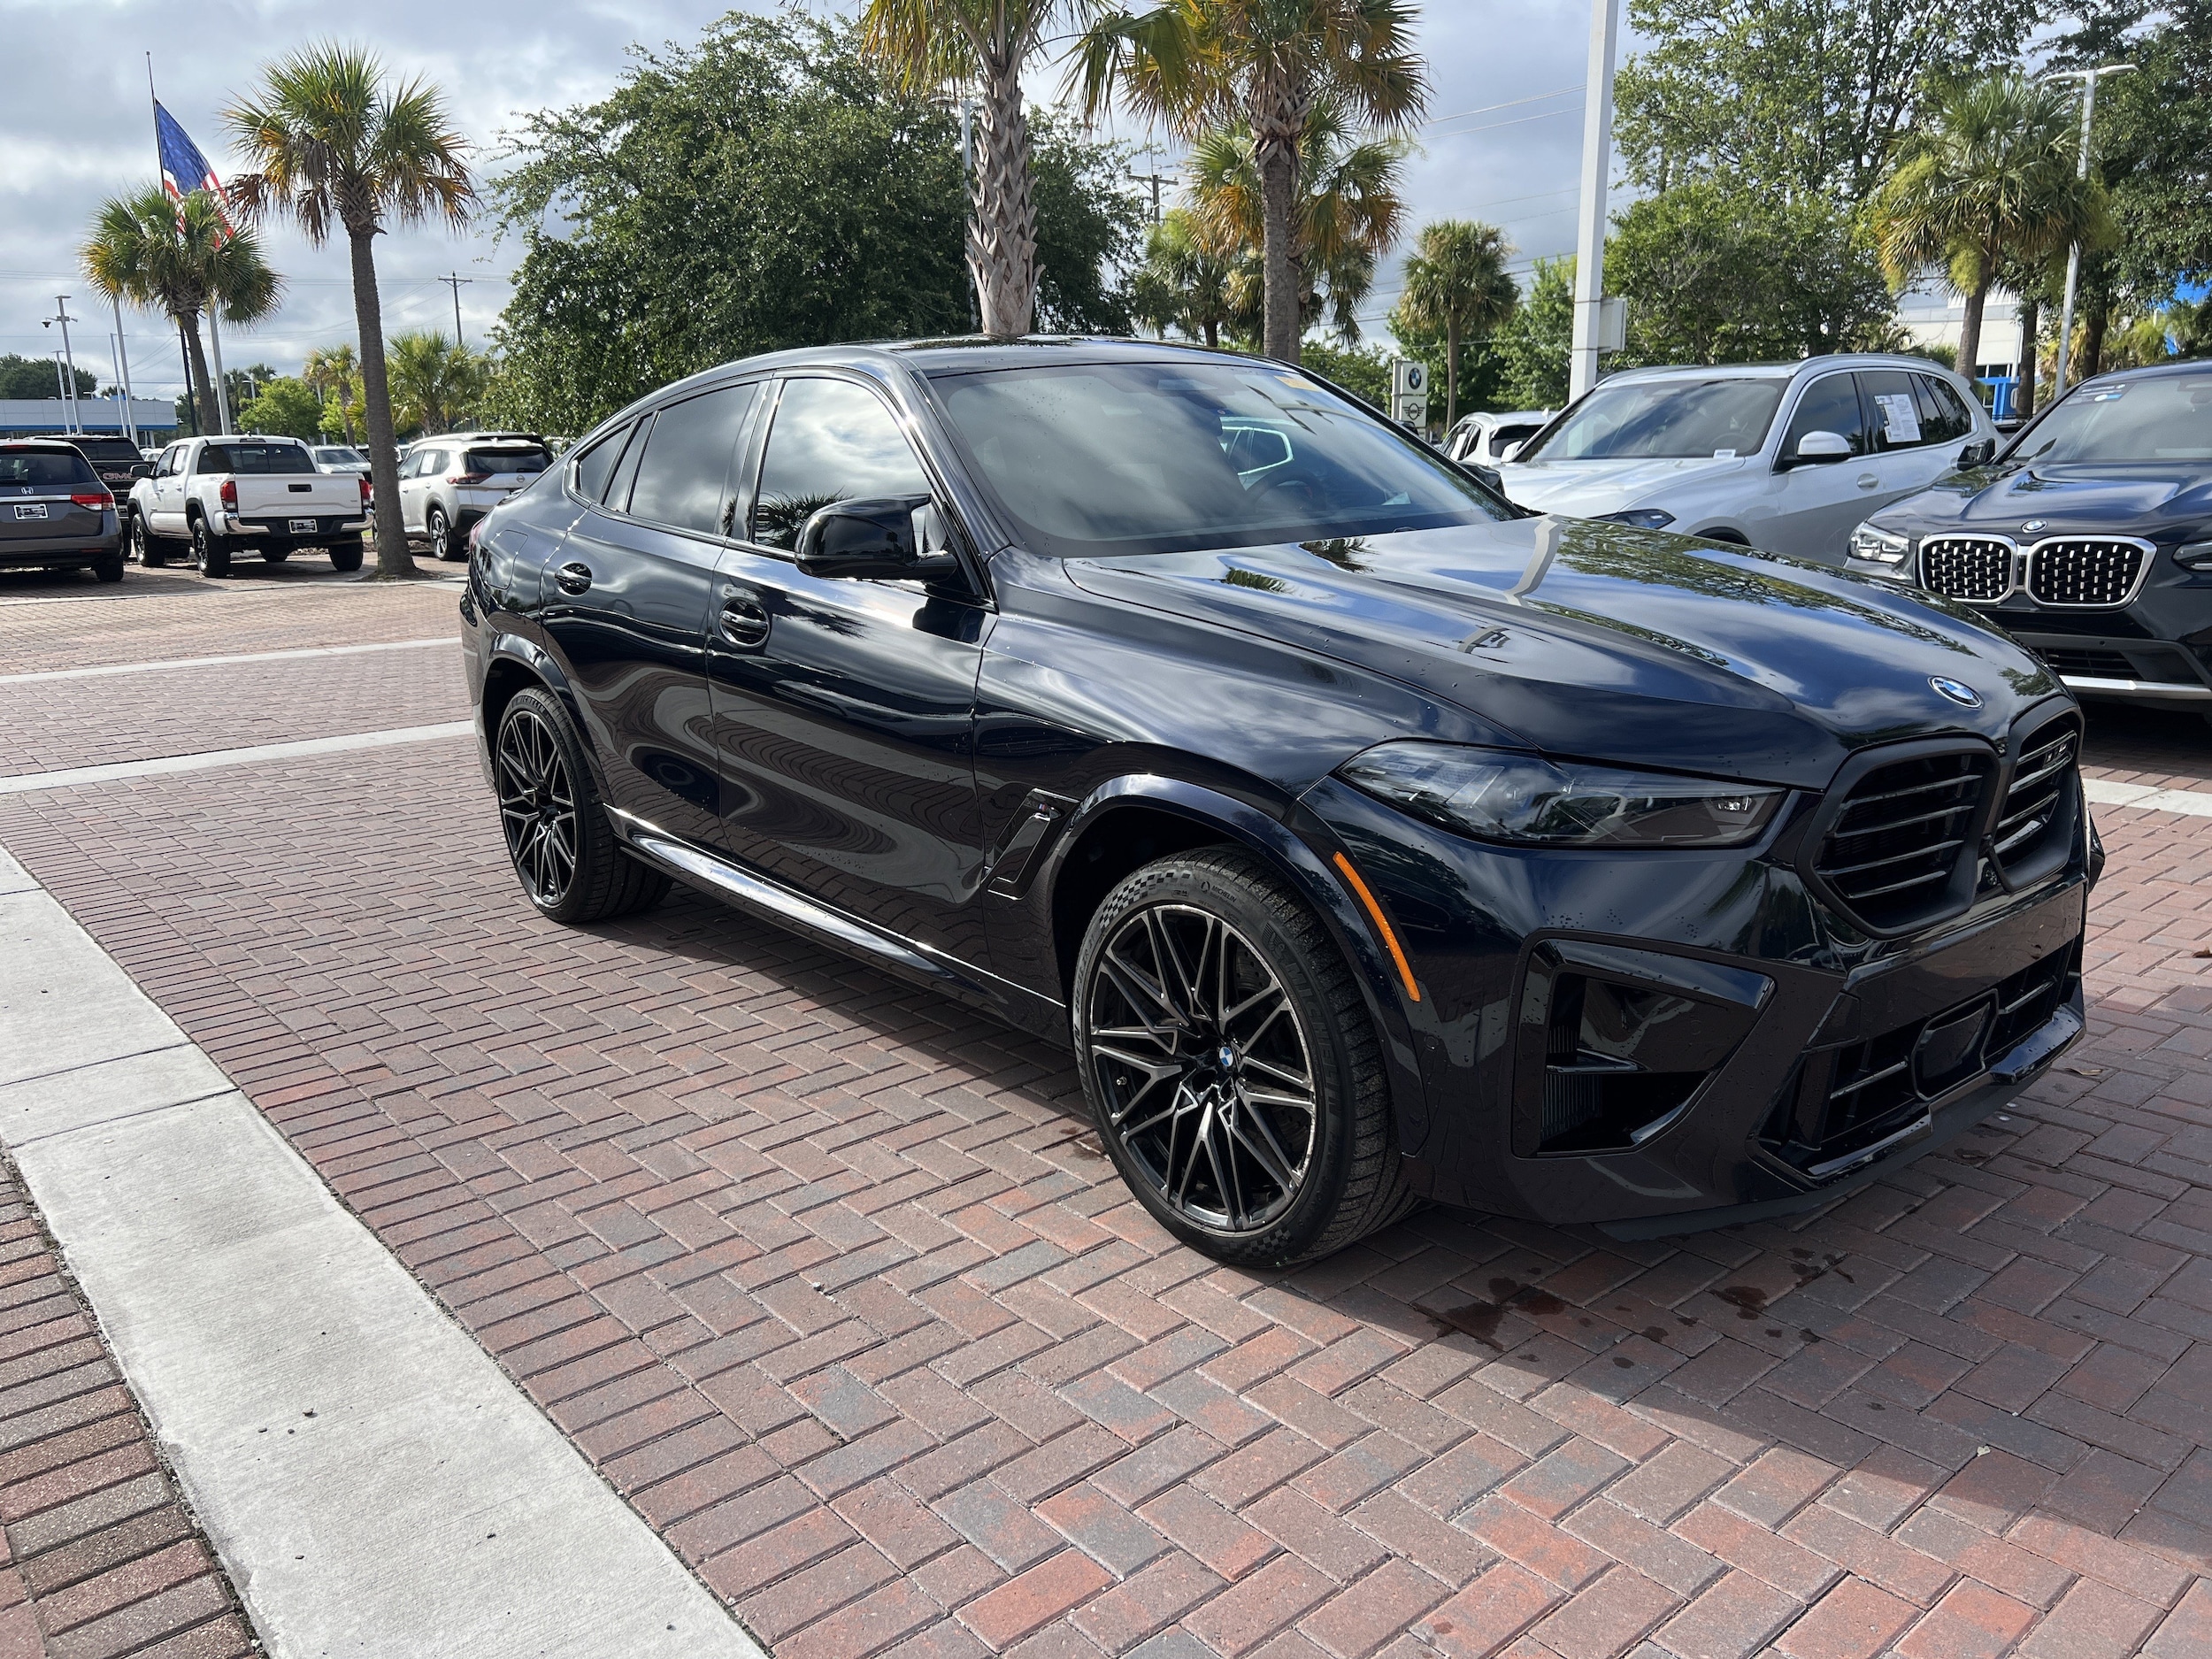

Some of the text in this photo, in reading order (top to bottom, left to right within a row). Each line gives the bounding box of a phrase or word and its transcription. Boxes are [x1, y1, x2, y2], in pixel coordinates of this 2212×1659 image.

[517, 696, 545, 713] MICHELIN
[1211, 884, 1238, 903] MICHELIN
[1286, 961, 1343, 1118] MICHELIN
